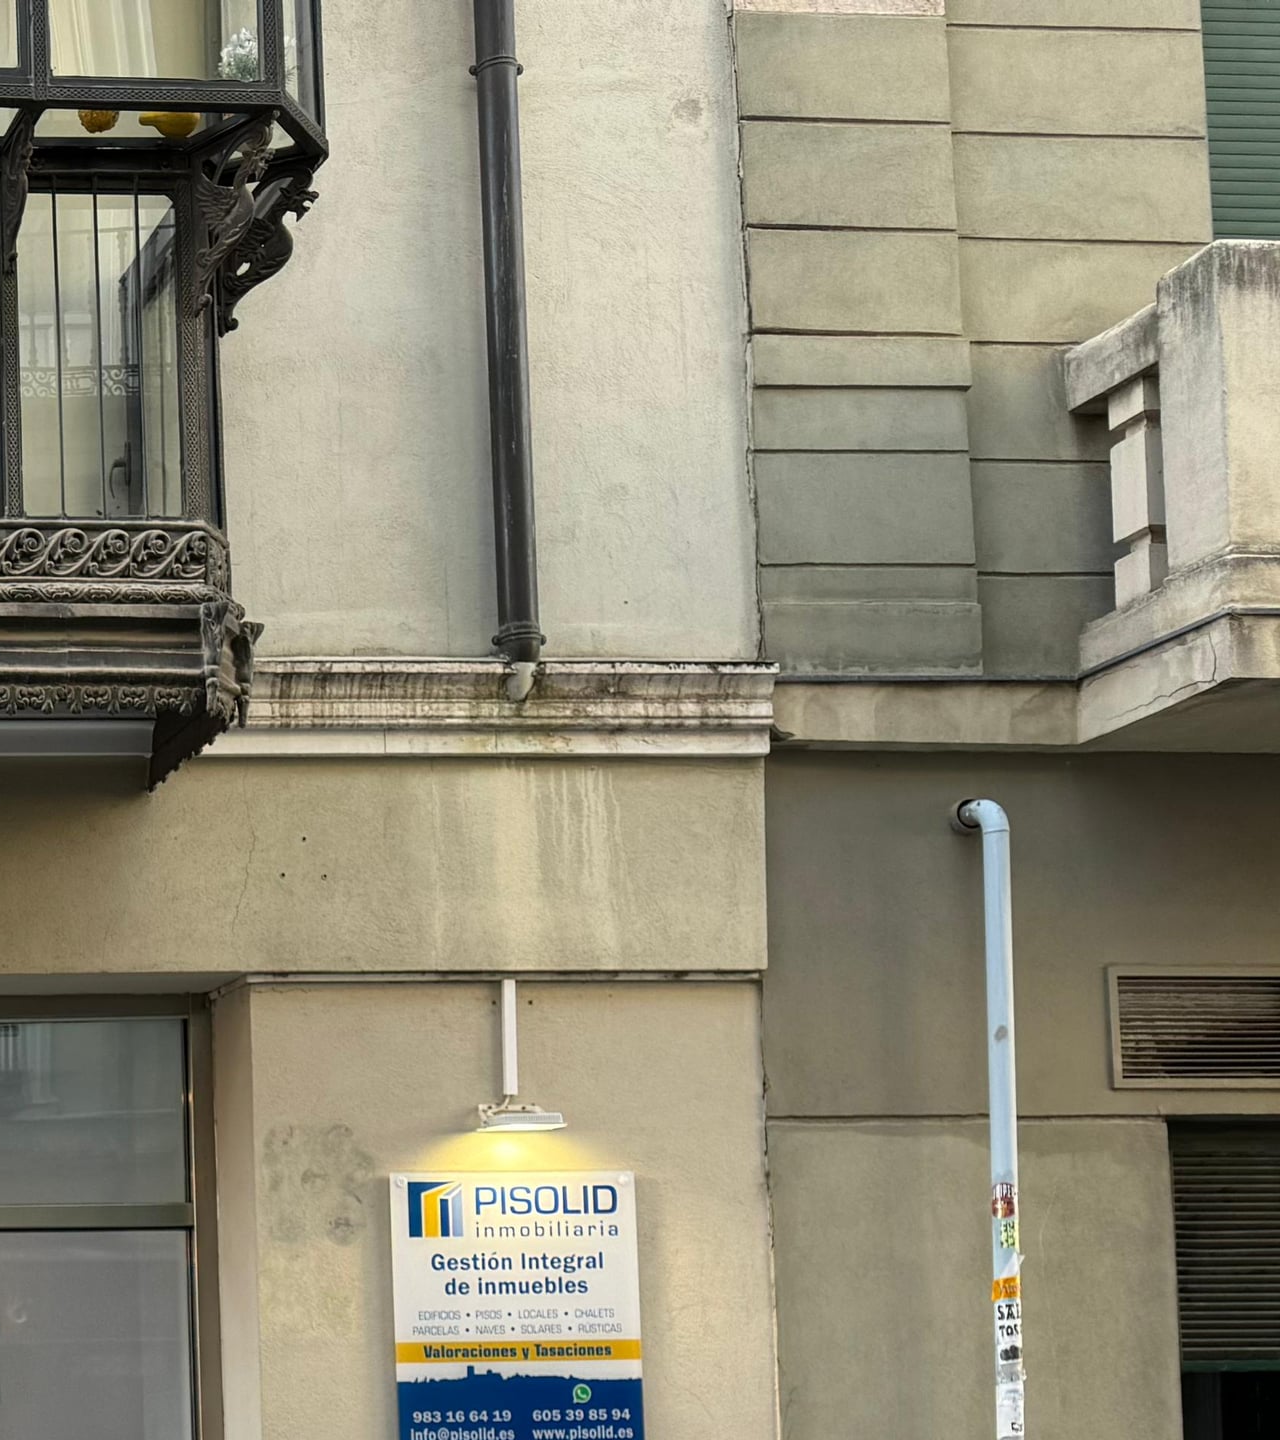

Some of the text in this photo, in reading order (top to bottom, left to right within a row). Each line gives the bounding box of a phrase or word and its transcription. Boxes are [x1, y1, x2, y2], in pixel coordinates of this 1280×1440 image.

[475, 1184, 618, 1215] PISOLID
[476, 1220, 619, 1238] inmobiliaria
[431, 1251, 604, 1274] Gestión Integral
[445, 1276, 588, 1295] de inmuebles
[418, 1307, 615, 1321] EDIFICIOS PISOS LOCALES CHALETS
[412, 1325, 460, 1336] PARCELAS
[475, 1324, 506, 1336] NAVES
[520, 1323, 562, 1335] SOLARES
[423, 1342, 612, 1361] Valoraciones y Tasaciones
[412, 1409, 512, 1423] 983 16 64 19
[532, 1407, 631, 1422] 605 39 85 94
